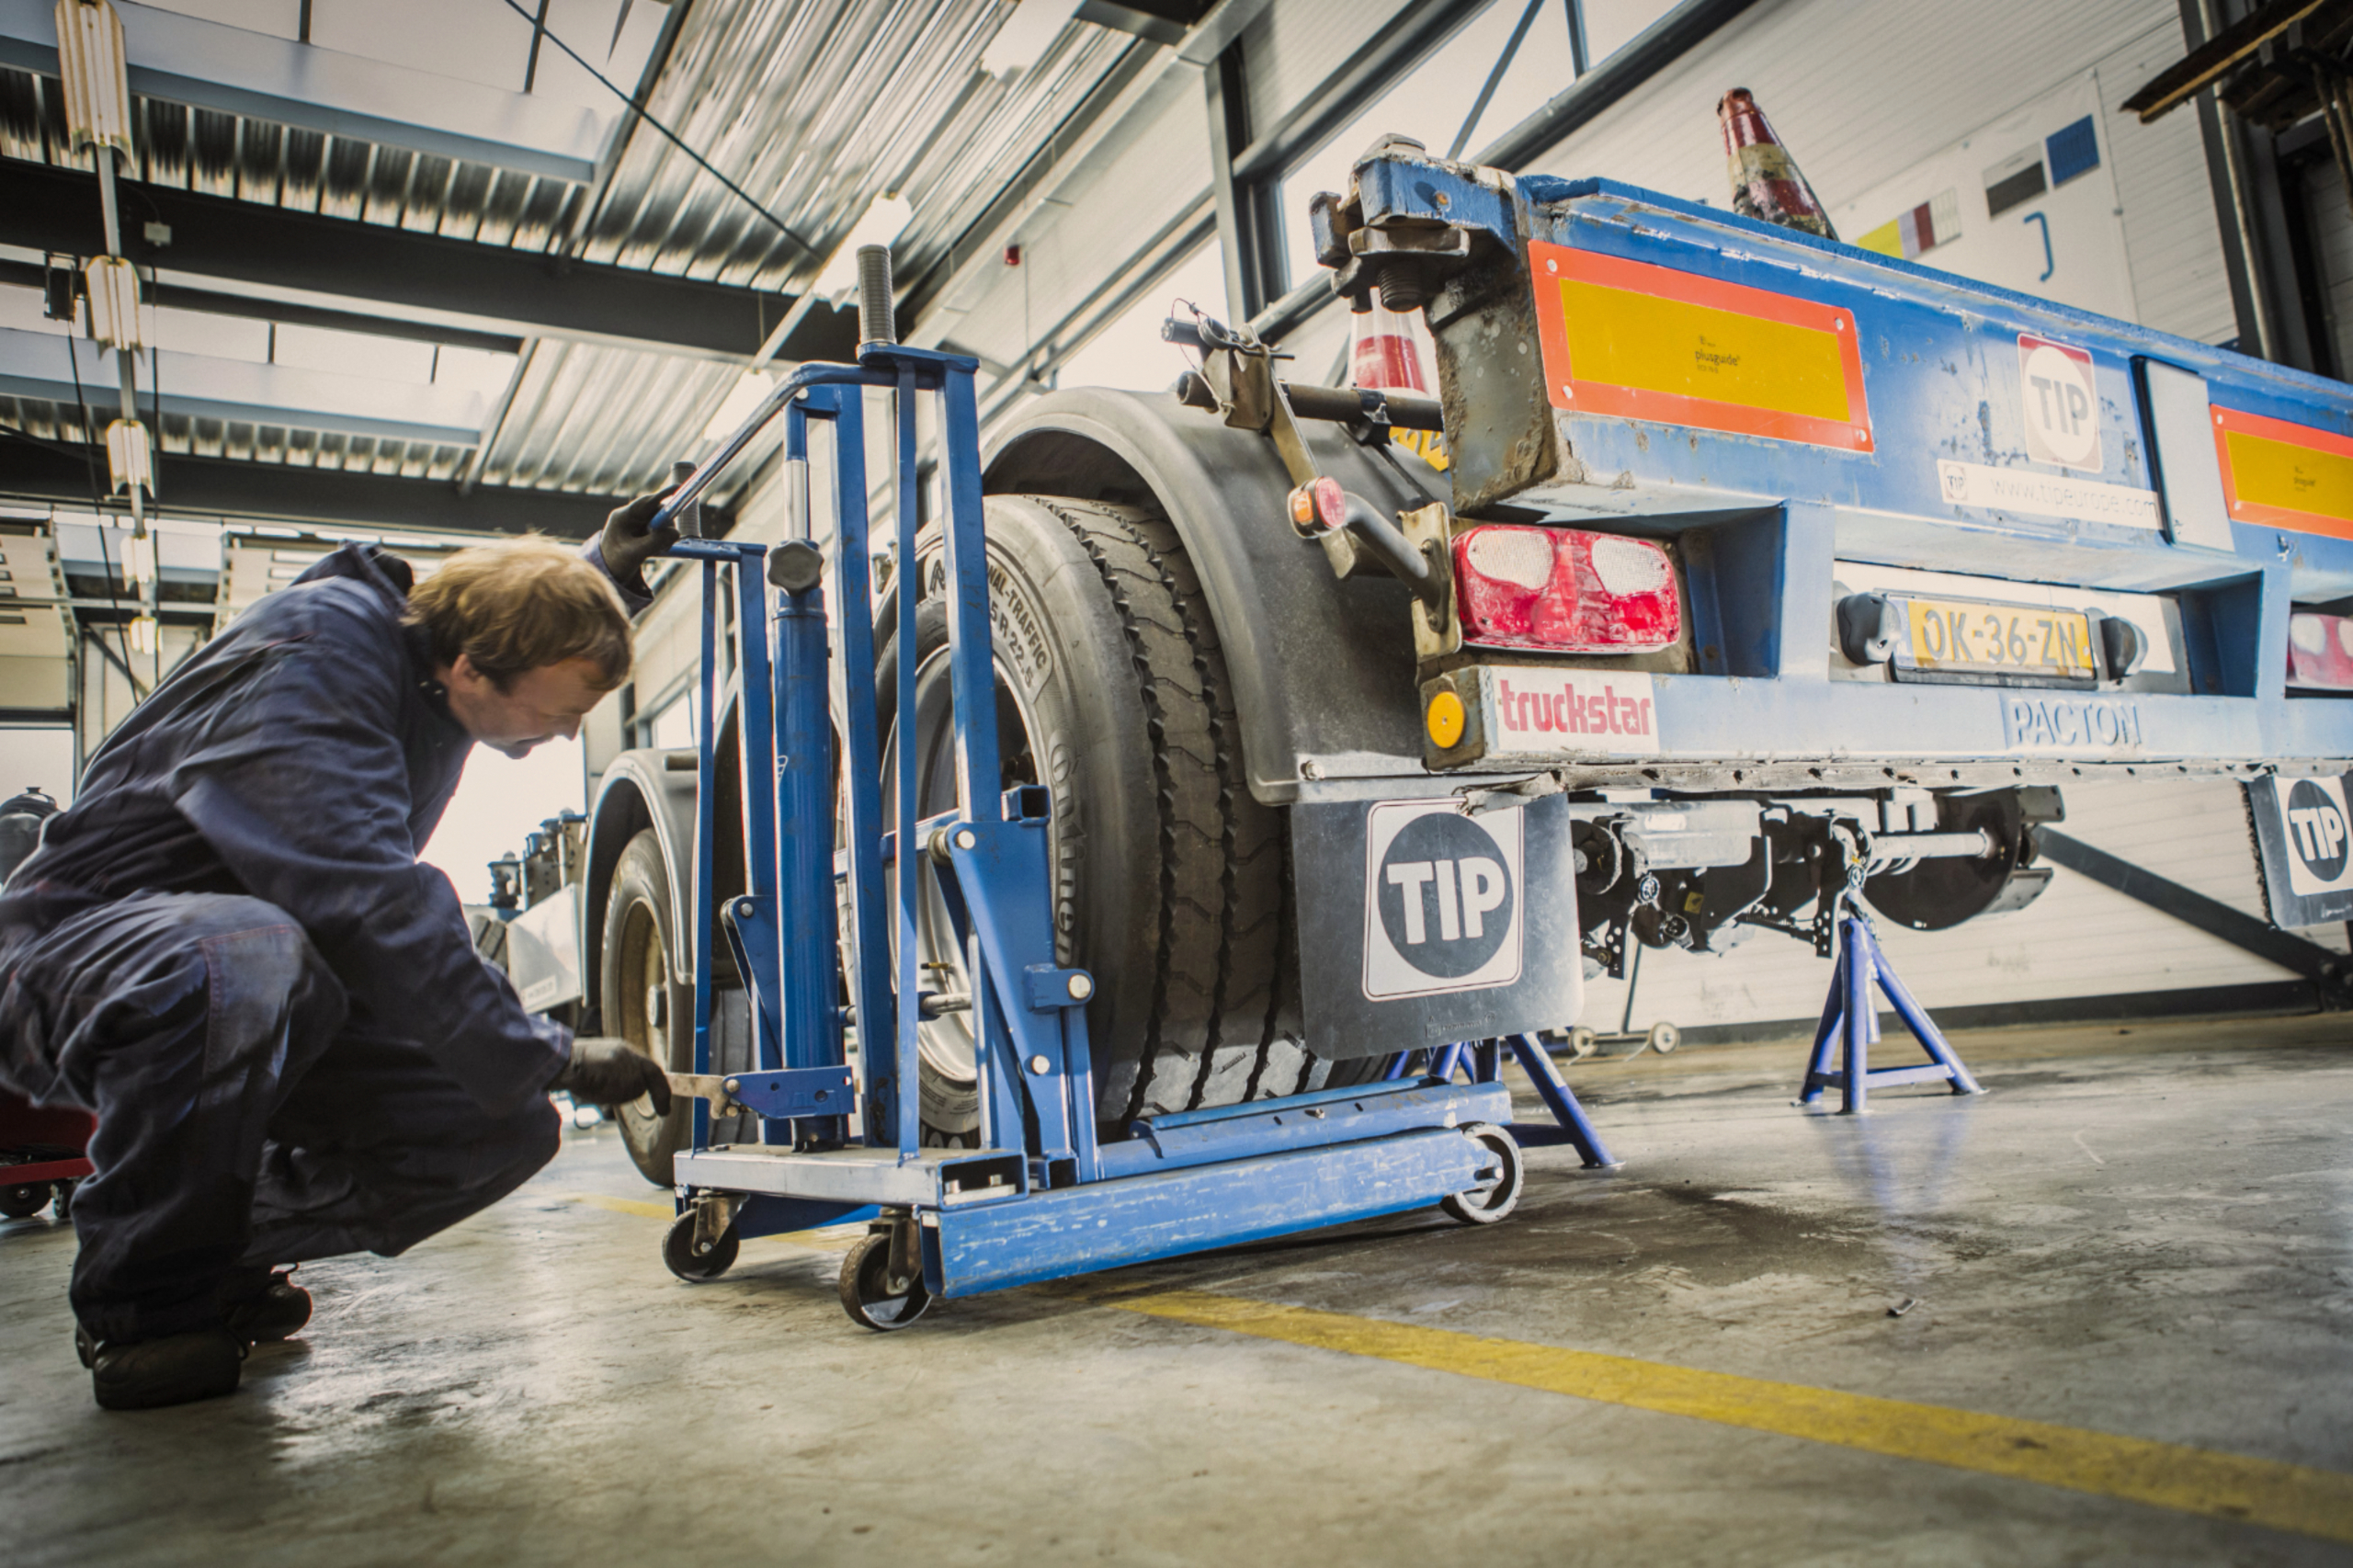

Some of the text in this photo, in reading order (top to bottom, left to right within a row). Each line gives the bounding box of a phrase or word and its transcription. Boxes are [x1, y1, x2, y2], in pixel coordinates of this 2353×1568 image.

[2029, 374, 2089, 437] TIP
[1947, 474, 1965, 492] TIP
[1991, 478, 2158, 518] www.tipeurope.com
[987, 562, 1048, 671] NAL-TRAFFIC
[1923, 609, 2080, 665] OK-36-ZN
[1000, 611, 1010, 639] R
[1009, 631, 1035, 687] 22.5
[1499, 679, 1652, 736] truckstar
[2009, 699, 2143, 746] PACTON
[1048, 729, 1087, 966] Continen
[2289, 806, 2345, 862] TIP
[1386, 856, 1506, 945] TIP
